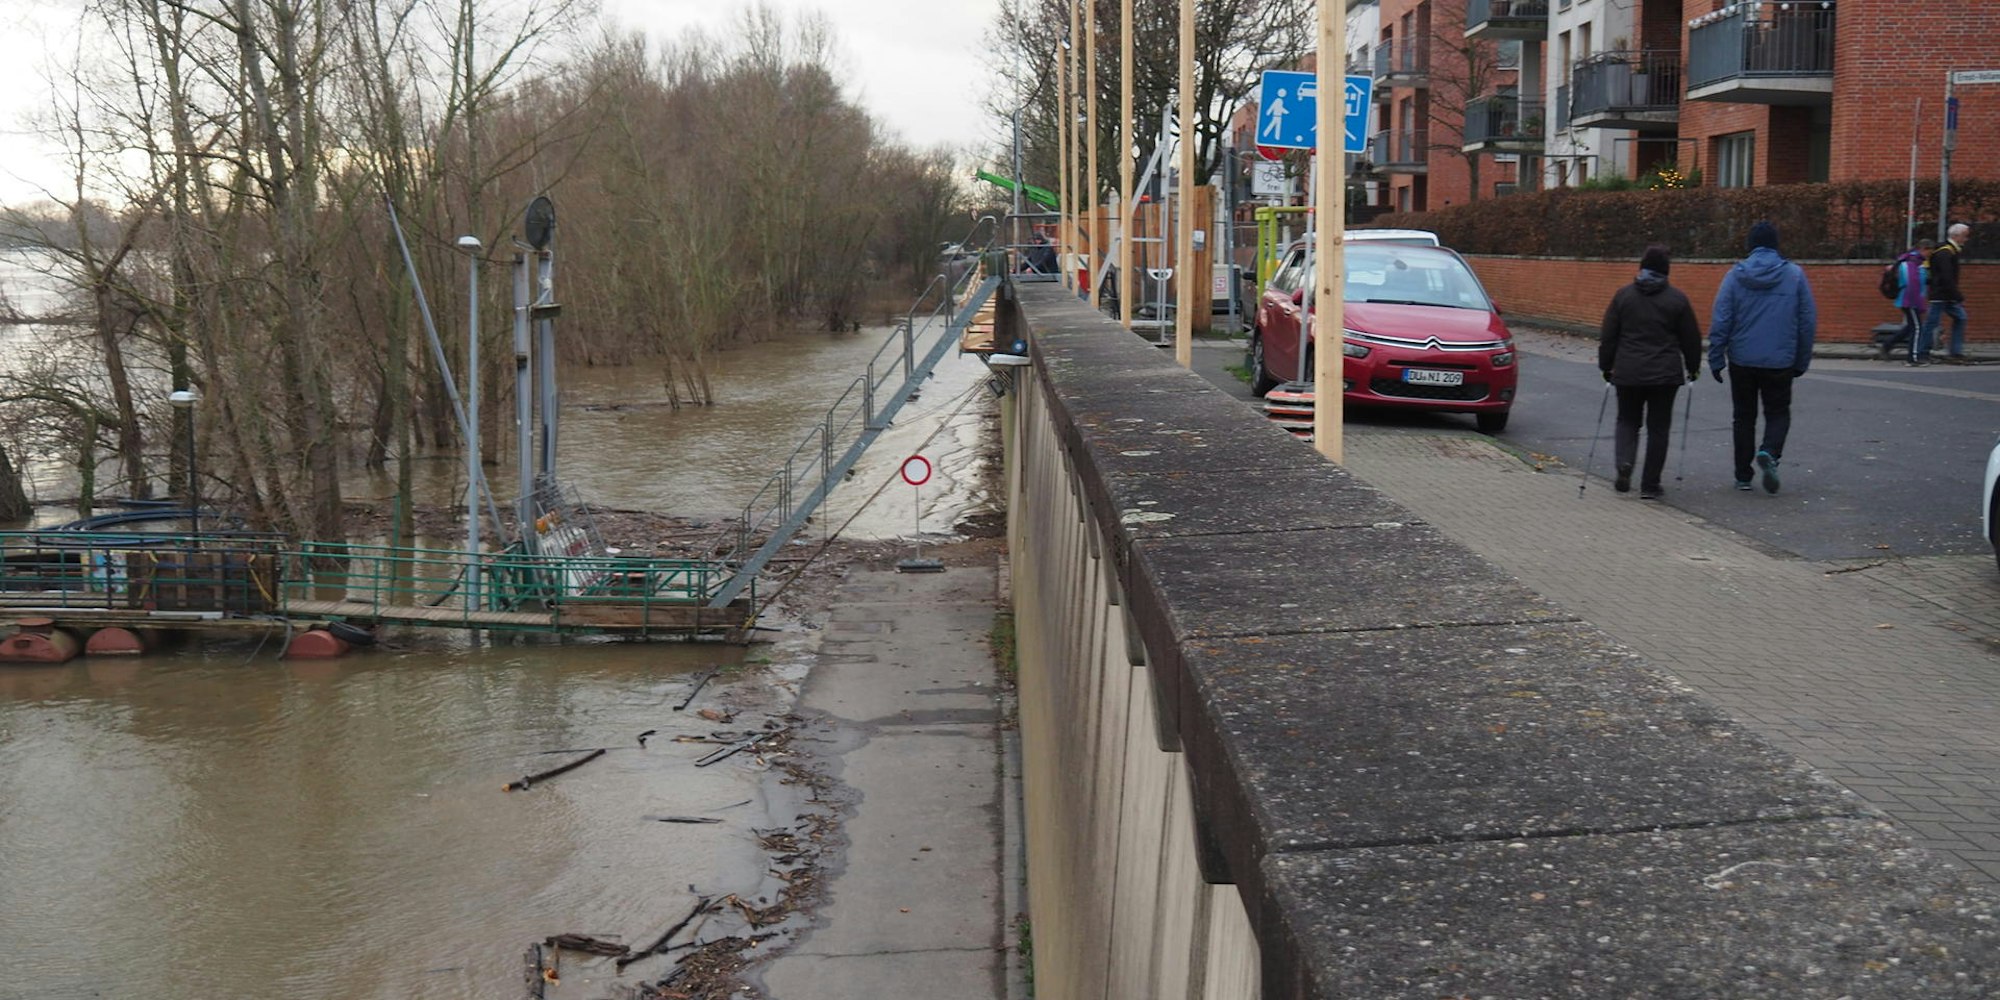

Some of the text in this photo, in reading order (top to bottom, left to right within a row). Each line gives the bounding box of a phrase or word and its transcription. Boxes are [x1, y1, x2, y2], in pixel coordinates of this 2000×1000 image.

[1267, 183, 1281, 191] frei
[1410, 371, 1422, 381] DU
[1443, 373, 1461, 383] 209
